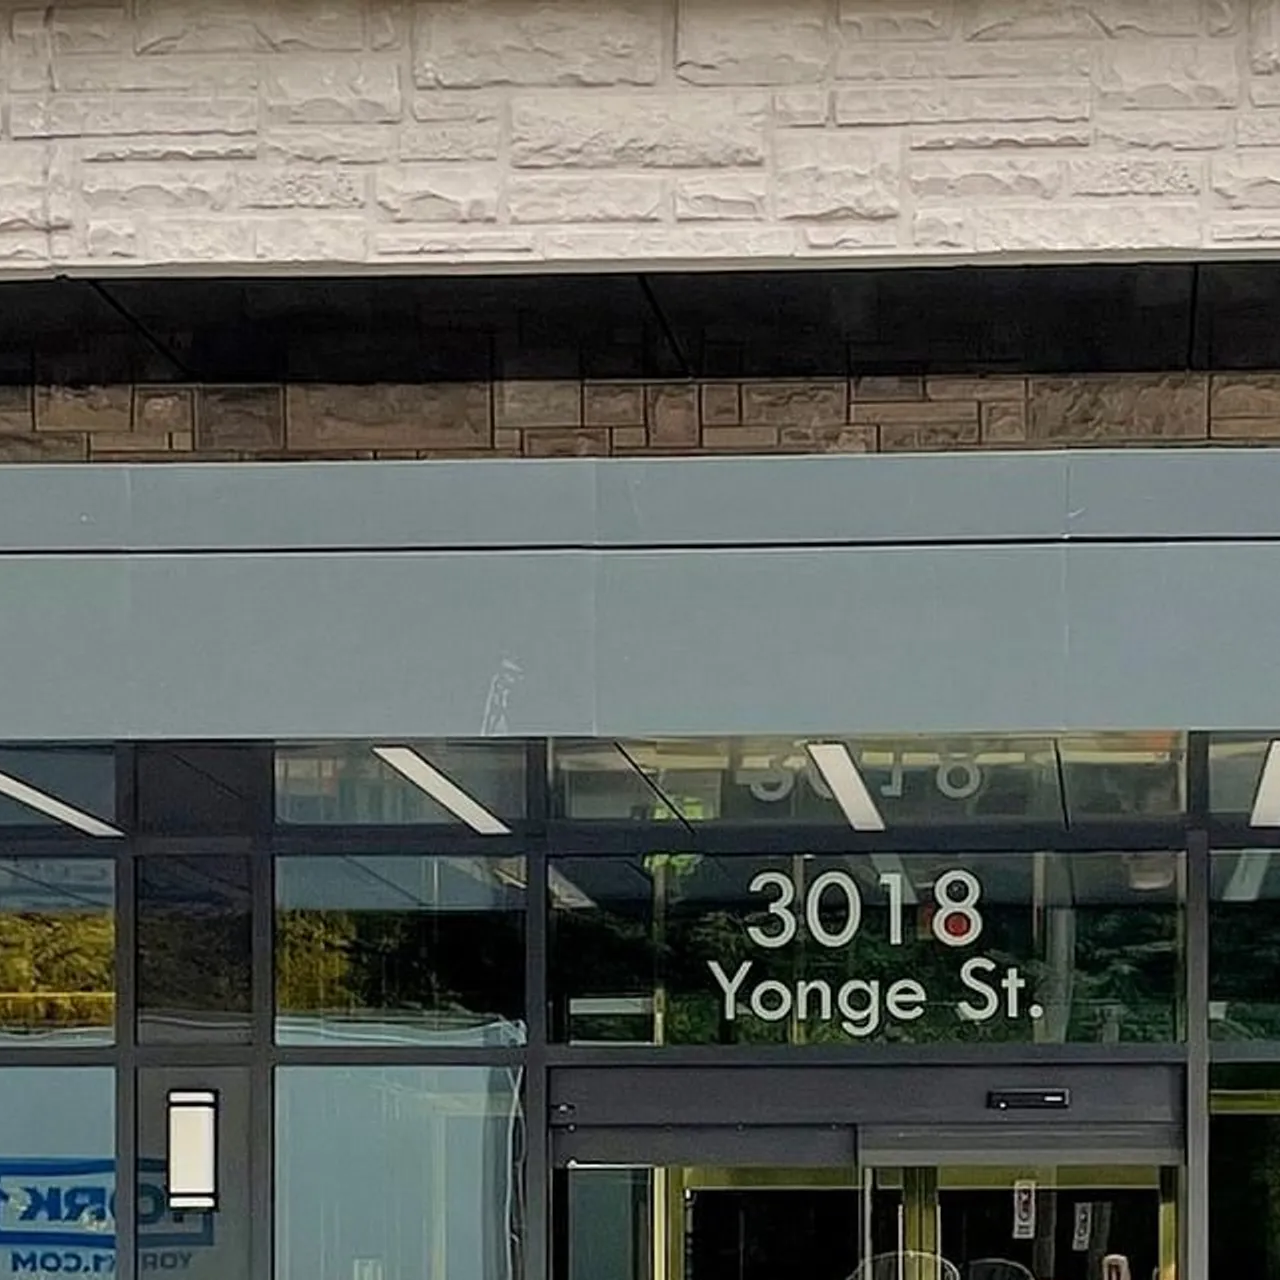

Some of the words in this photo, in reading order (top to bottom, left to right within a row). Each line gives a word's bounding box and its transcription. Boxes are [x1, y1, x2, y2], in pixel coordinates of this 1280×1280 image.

[747, 869, 983, 948] 3018
[707, 960, 927, 1037] Yonge
[957, 957, 1045, 1020] St.
